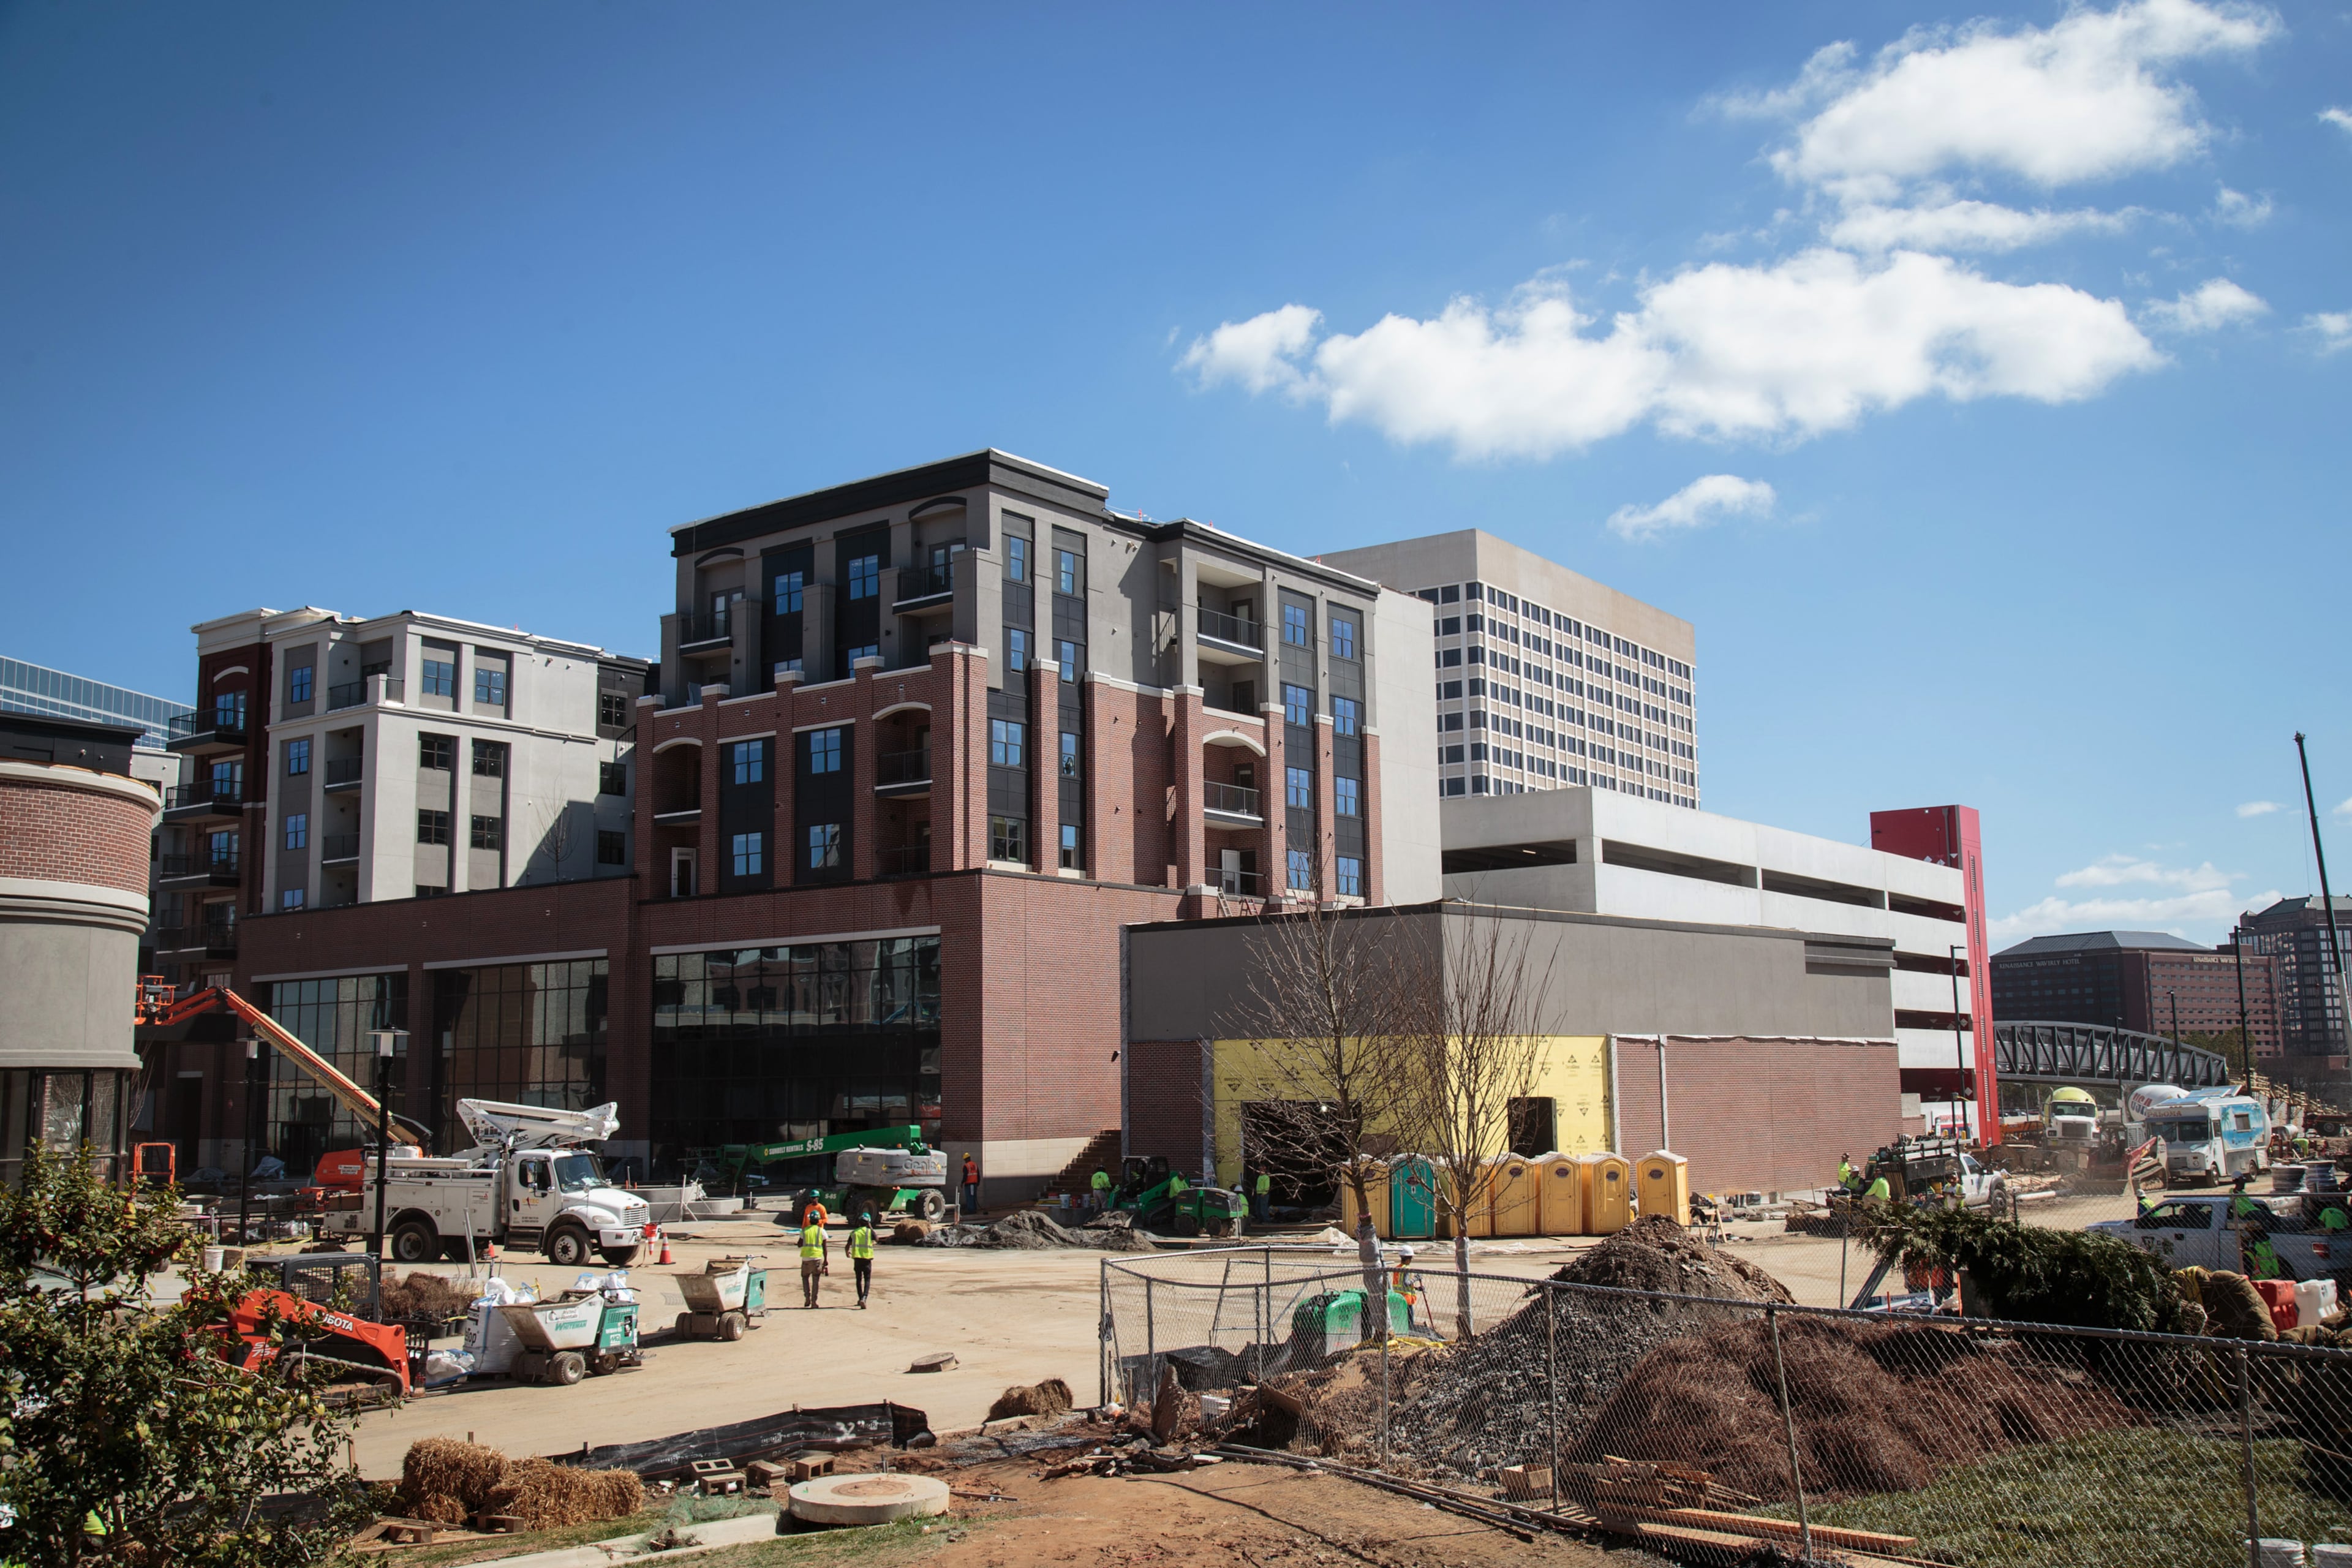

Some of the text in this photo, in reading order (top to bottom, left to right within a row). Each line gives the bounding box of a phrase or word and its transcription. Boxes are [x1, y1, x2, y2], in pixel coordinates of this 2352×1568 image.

[786, 1144, 804, 1153] RENTALS
[806, 1138, 824, 1152] S-85
[903, 1158, 937, 1171] Genie
[555, 1320, 588, 1331] WHITEMAN
